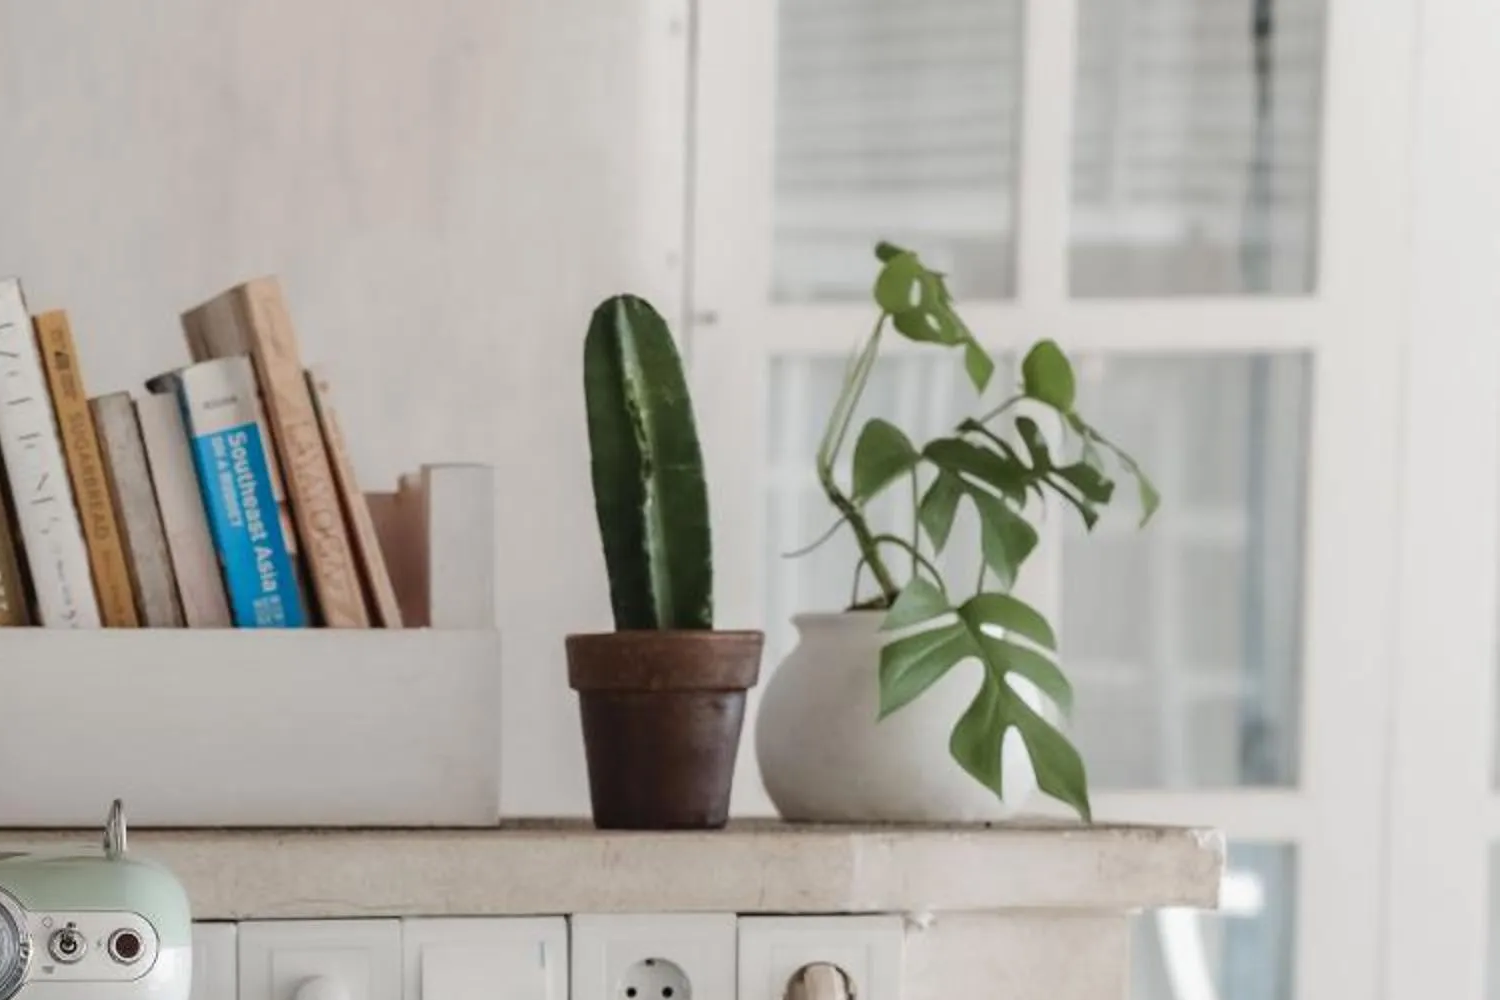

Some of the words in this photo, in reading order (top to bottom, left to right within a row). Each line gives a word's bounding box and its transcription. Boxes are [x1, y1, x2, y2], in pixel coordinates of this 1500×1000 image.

[67, 411, 111, 541] SUGARBREAD
[228, 432, 268, 541] Southeast
[254, 545, 278, 592] Asia
